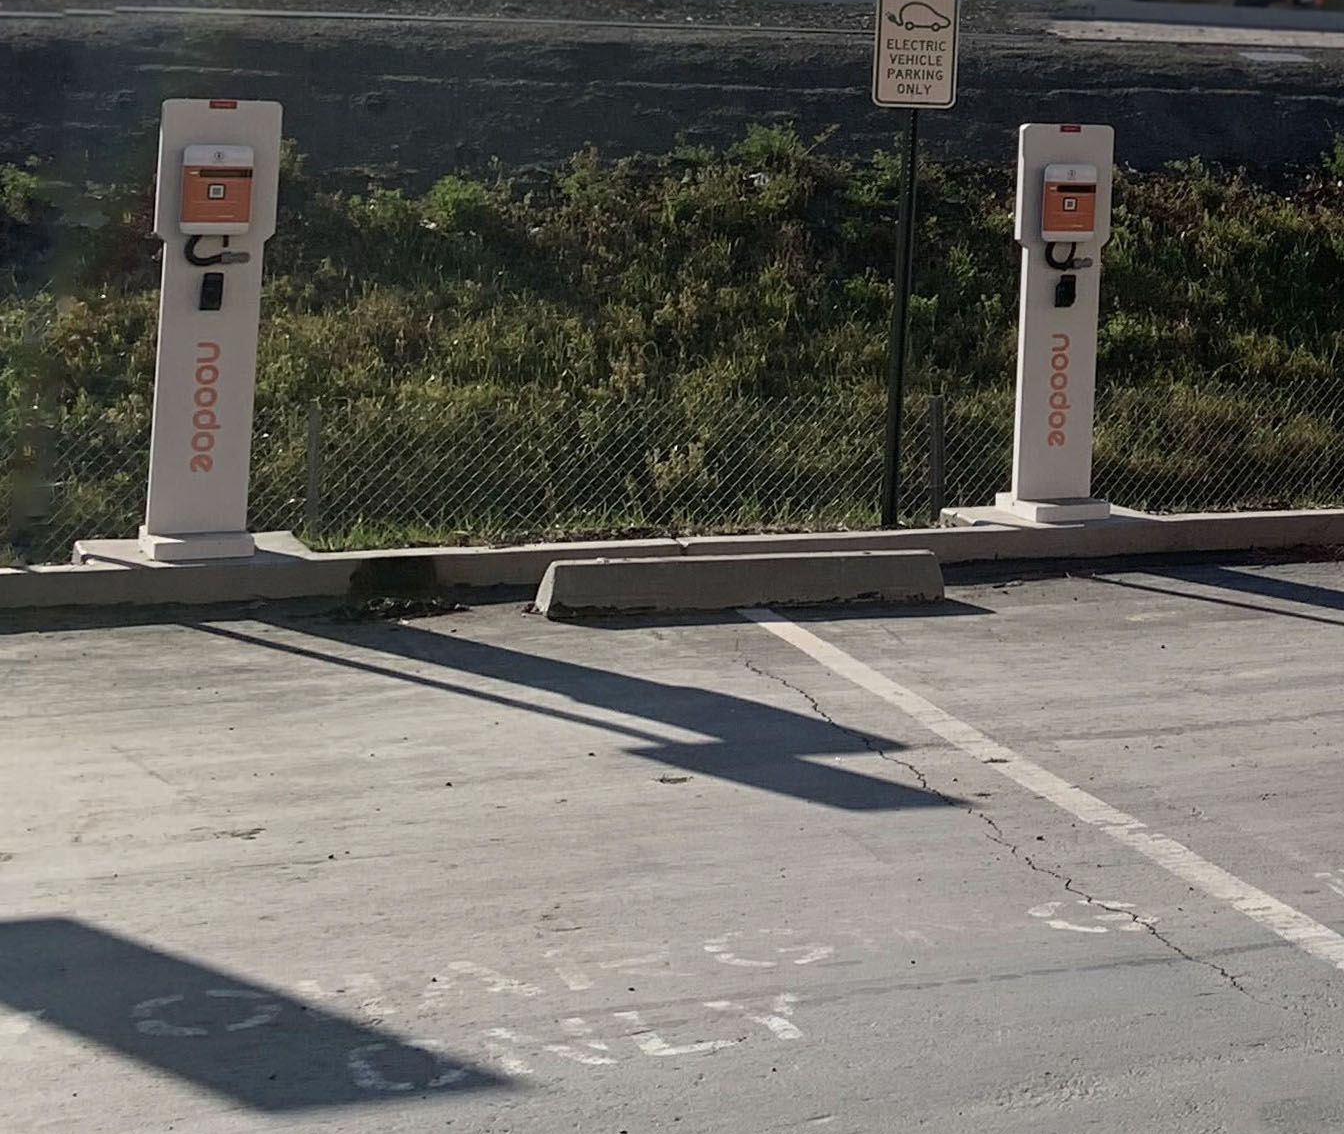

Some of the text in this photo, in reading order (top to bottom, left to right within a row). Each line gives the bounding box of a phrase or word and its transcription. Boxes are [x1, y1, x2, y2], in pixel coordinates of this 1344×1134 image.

[887, 38, 947, 52] ELECTRIC
[889, 53, 943, 66] VEHICLE
[887, 68, 943, 81] PARKING
[896, 82, 932, 95] ONLY
[1047, 333, 1072, 447] noodoe
[189, 341, 222, 473] noodoe
